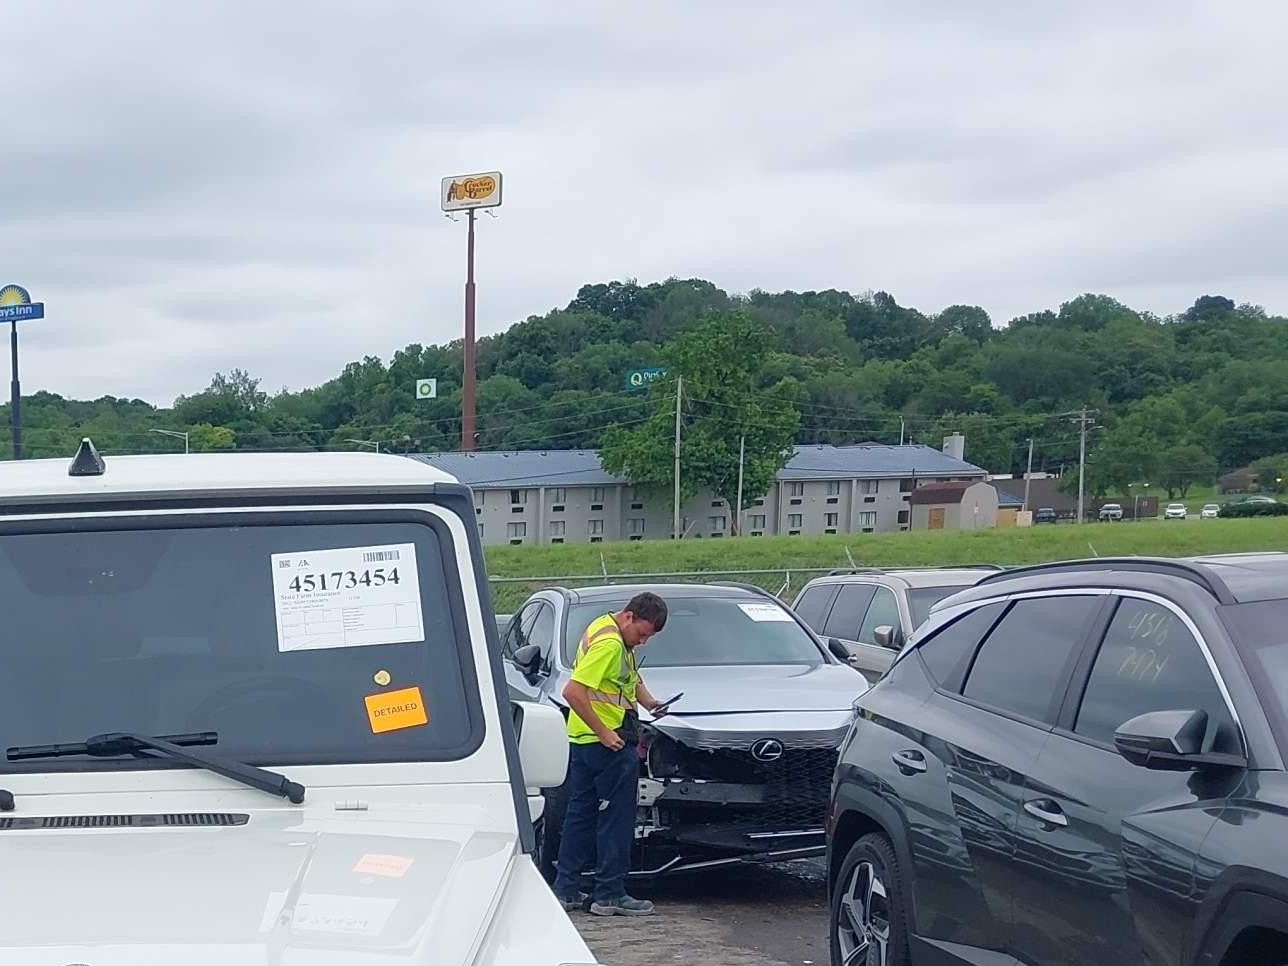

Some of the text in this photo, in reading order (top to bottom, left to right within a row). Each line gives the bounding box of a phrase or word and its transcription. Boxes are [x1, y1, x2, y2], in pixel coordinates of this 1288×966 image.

[15, 305, 33, 315] Inn
[289, 567, 400, 593] 45173454
[373, 702, 418, 718] DETAILED
